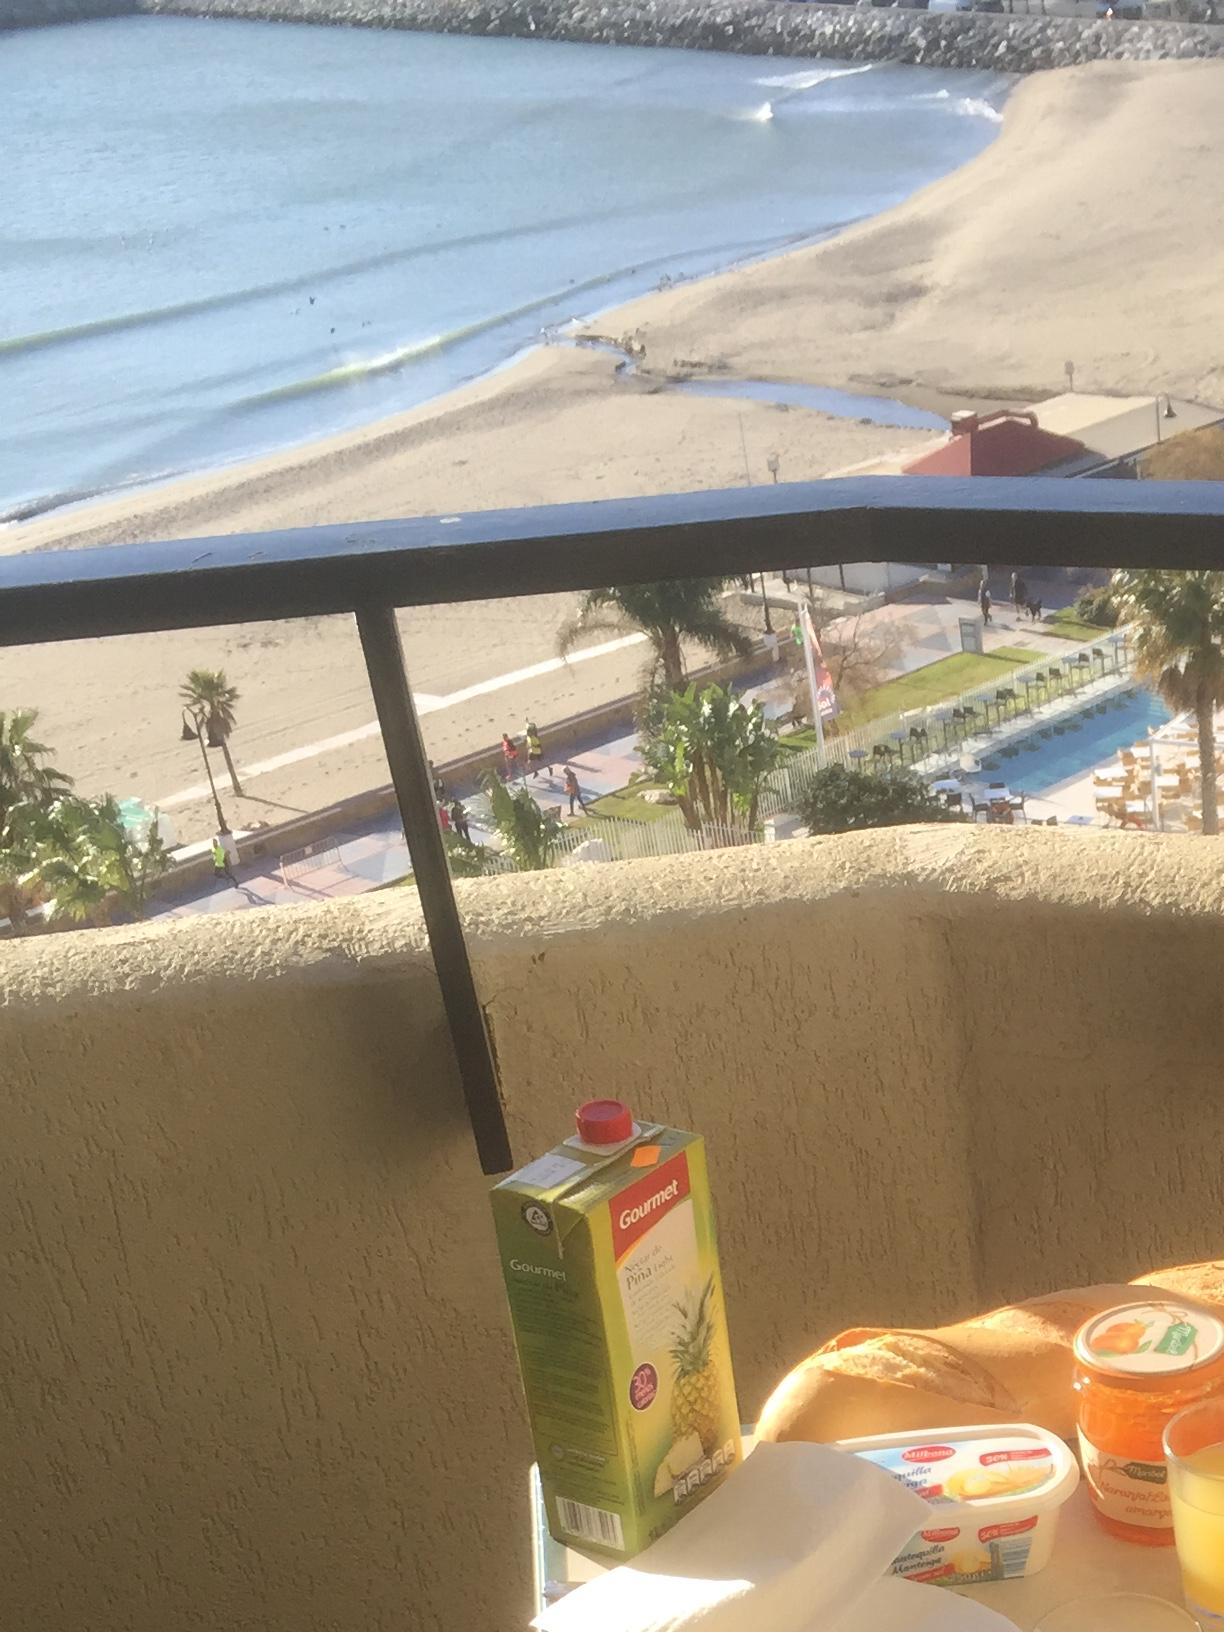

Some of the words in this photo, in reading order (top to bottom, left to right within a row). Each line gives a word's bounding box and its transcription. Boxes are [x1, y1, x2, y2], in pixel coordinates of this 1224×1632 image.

[619, 1179, 679, 1229] Gourmet
[510, 1259, 567, 1281] Gourmet
[904, 1450, 954, 1460] Milbona
